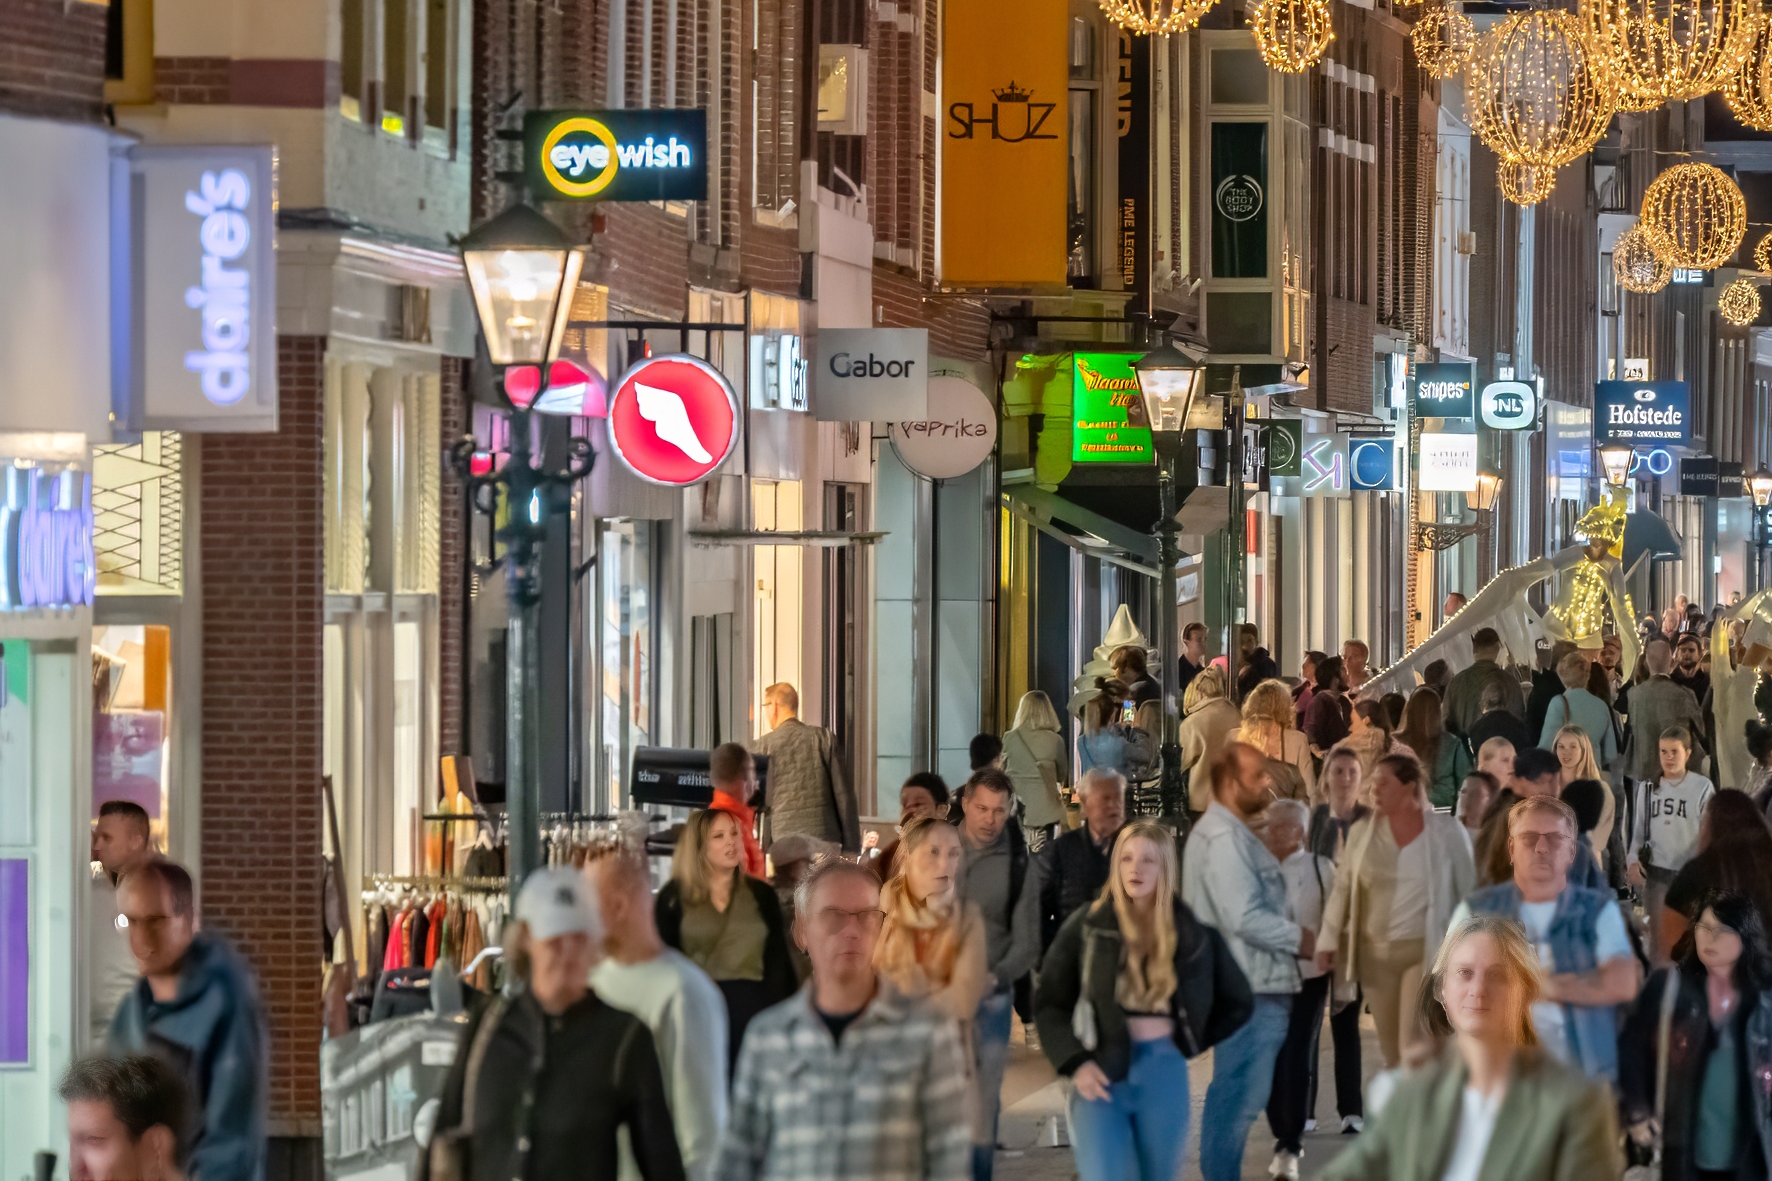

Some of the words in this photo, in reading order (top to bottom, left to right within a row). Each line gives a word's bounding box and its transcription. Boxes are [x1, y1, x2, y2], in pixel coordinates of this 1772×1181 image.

[948, 102, 1058, 143] SHUZ
[1124, 198, 1135, 227] PME
[1124, 231, 1135, 285] LEGEND
[184, 168, 250, 406] claire's
[829, 352, 915, 378] Gabor
[1608, 404, 1682, 426] Hofstede
[1651, 798, 1687, 818] USA
